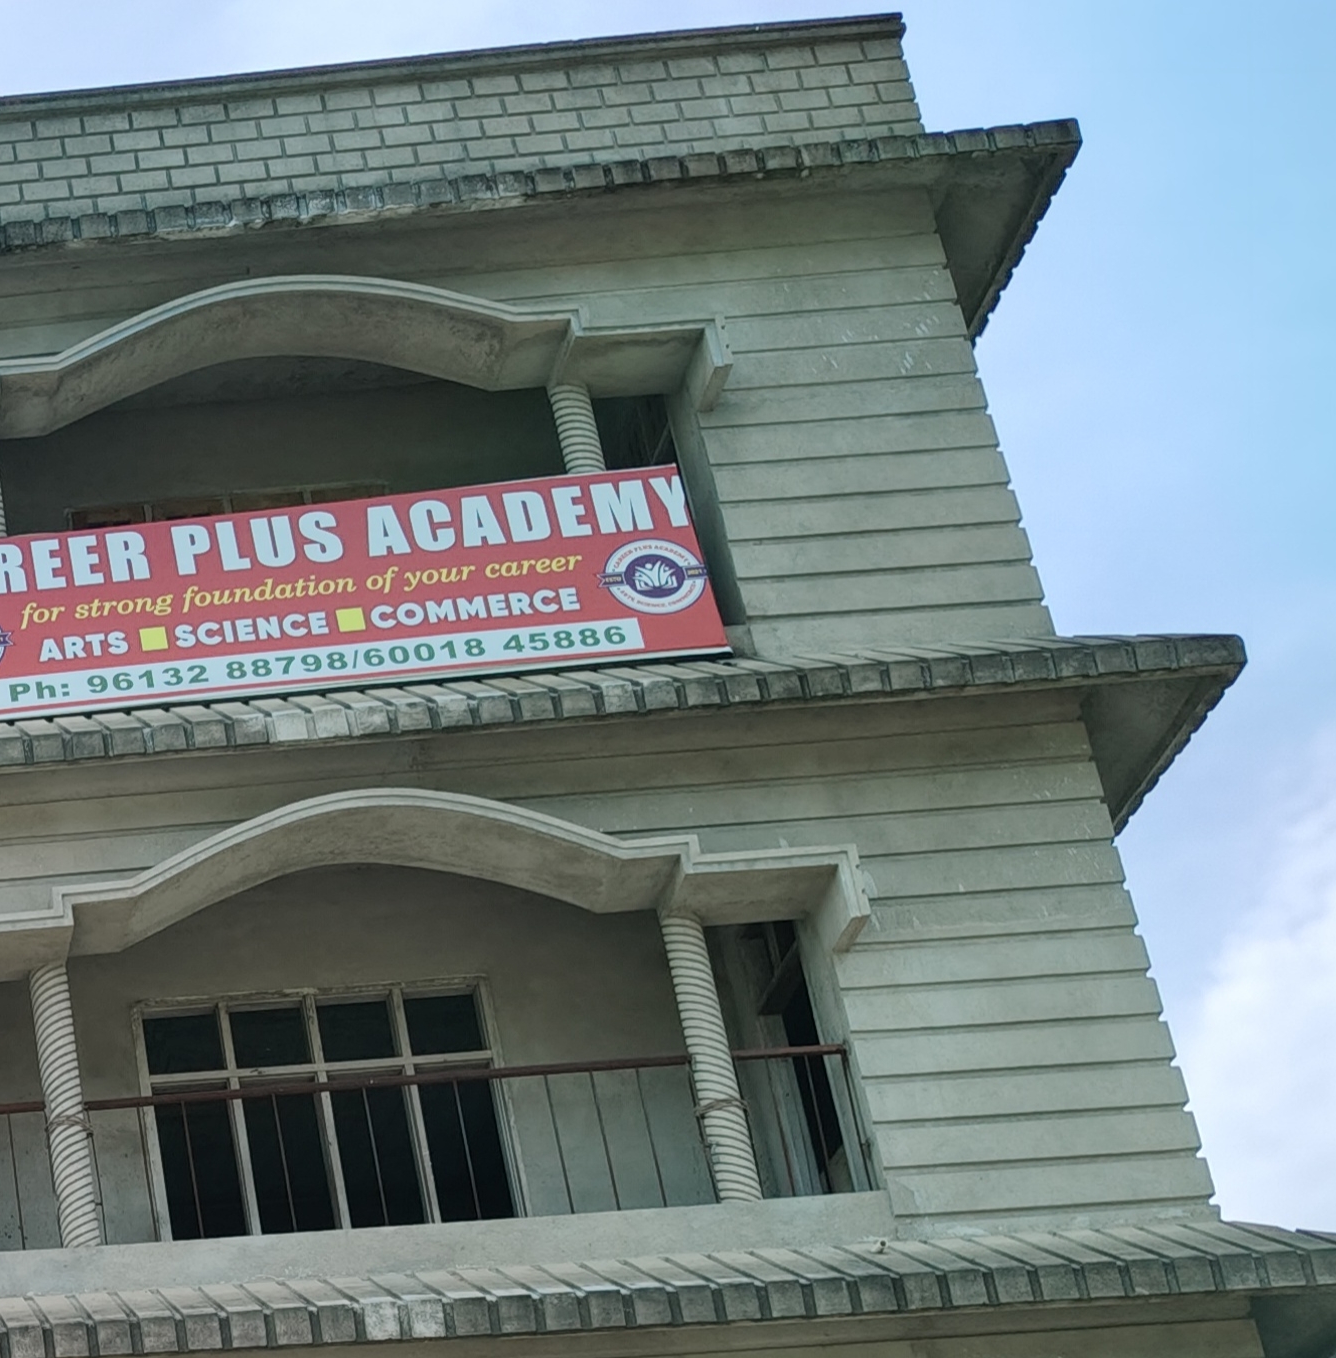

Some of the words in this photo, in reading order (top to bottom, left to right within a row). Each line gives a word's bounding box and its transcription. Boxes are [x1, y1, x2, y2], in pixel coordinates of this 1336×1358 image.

[170, 511, 344, 576] PLUS
[366, 474, 689, 558] ACADEMY
[20, 602, 66, 630] for
[74, 593, 174, 620] strong
[181, 575, 357, 613] foundation
[365, 566, 399, 594] of
[403, 565, 476, 593] your
[484, 554, 583, 579] career
[39, 631, 129, 663] ARTS
[174, 611, 330, 648] SCIENCE
[370, 587, 581, 629] COMMERCE
[8, 681, 71, 703] Ph:
[86, 665, 209, 694] 96132
[225, 638, 486, 681] 88798/60018
[502, 625, 627, 653] 45886
